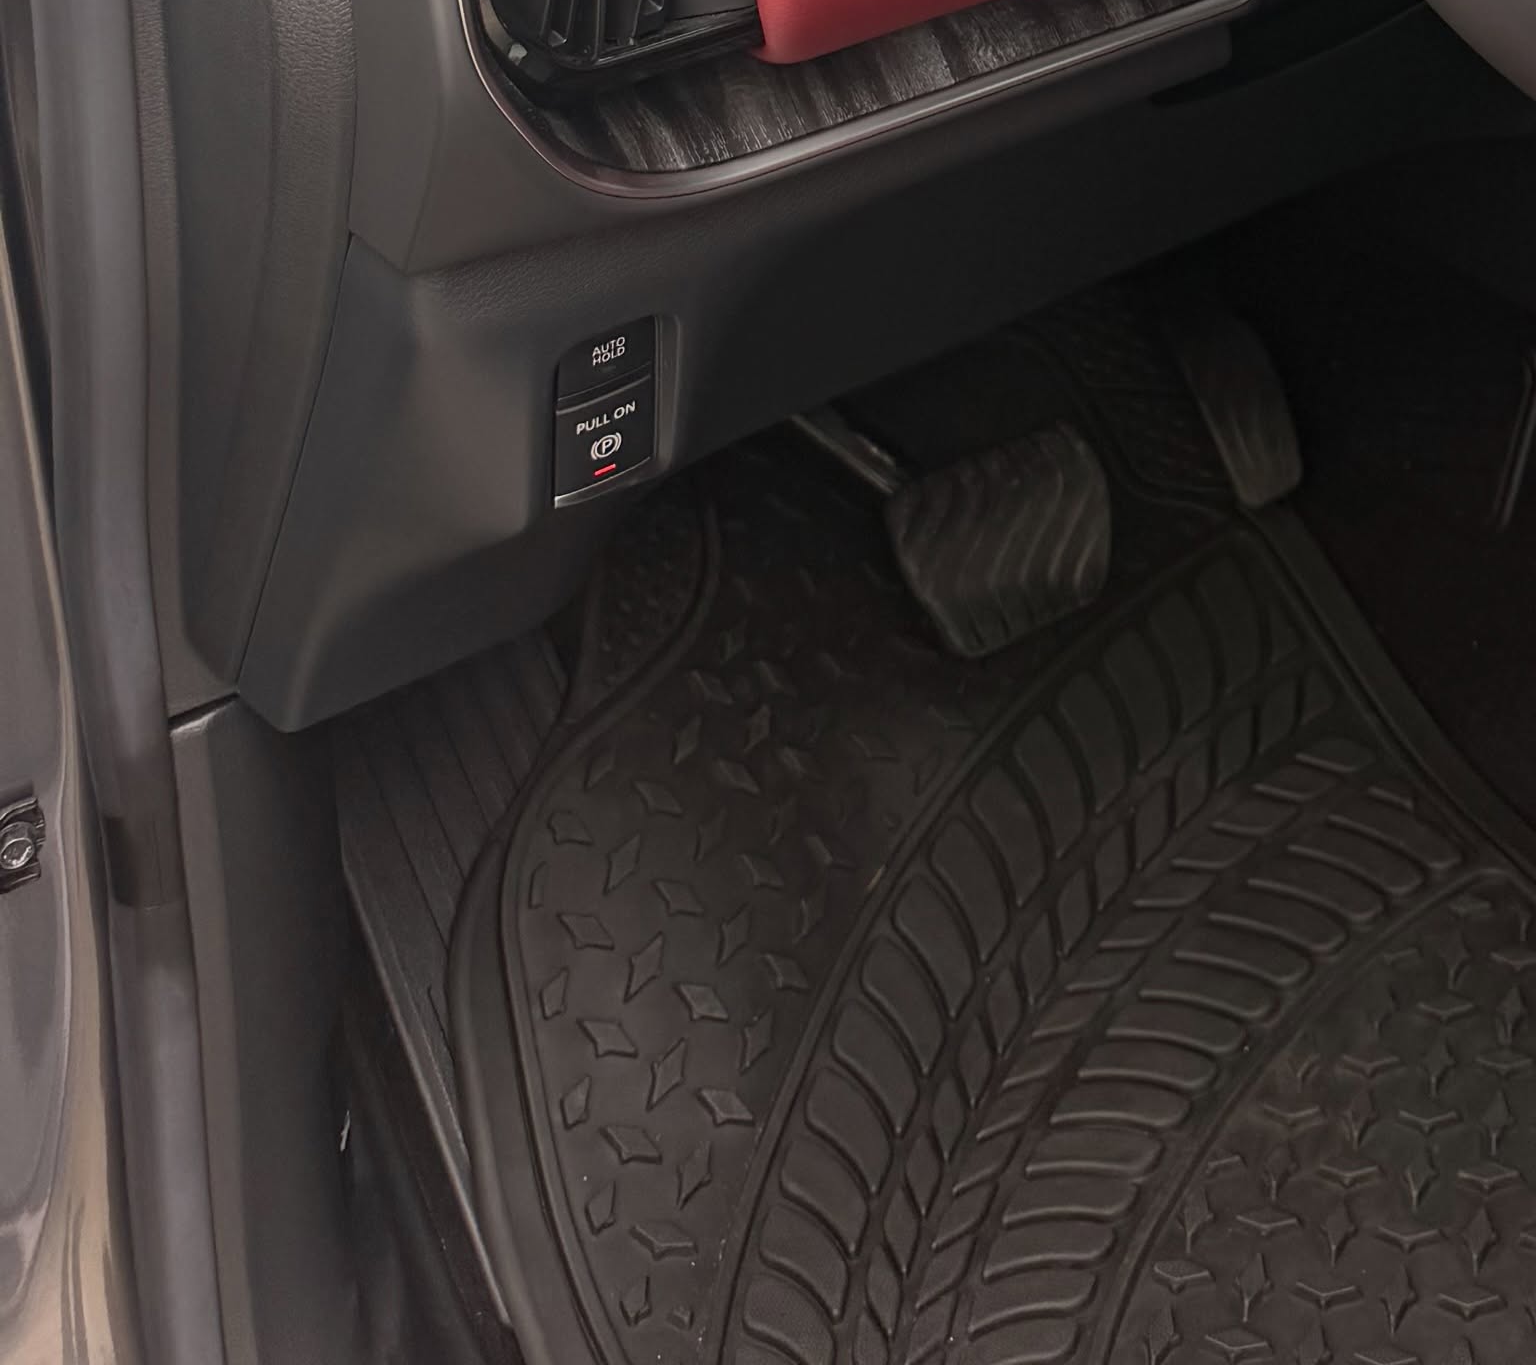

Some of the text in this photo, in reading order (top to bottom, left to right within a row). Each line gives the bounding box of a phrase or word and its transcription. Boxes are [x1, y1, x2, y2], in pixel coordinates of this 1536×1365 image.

[593, 337, 625, 356] AUTO
[593, 347, 625, 366] HOLD
[577, 401, 635, 435] PULL ON
